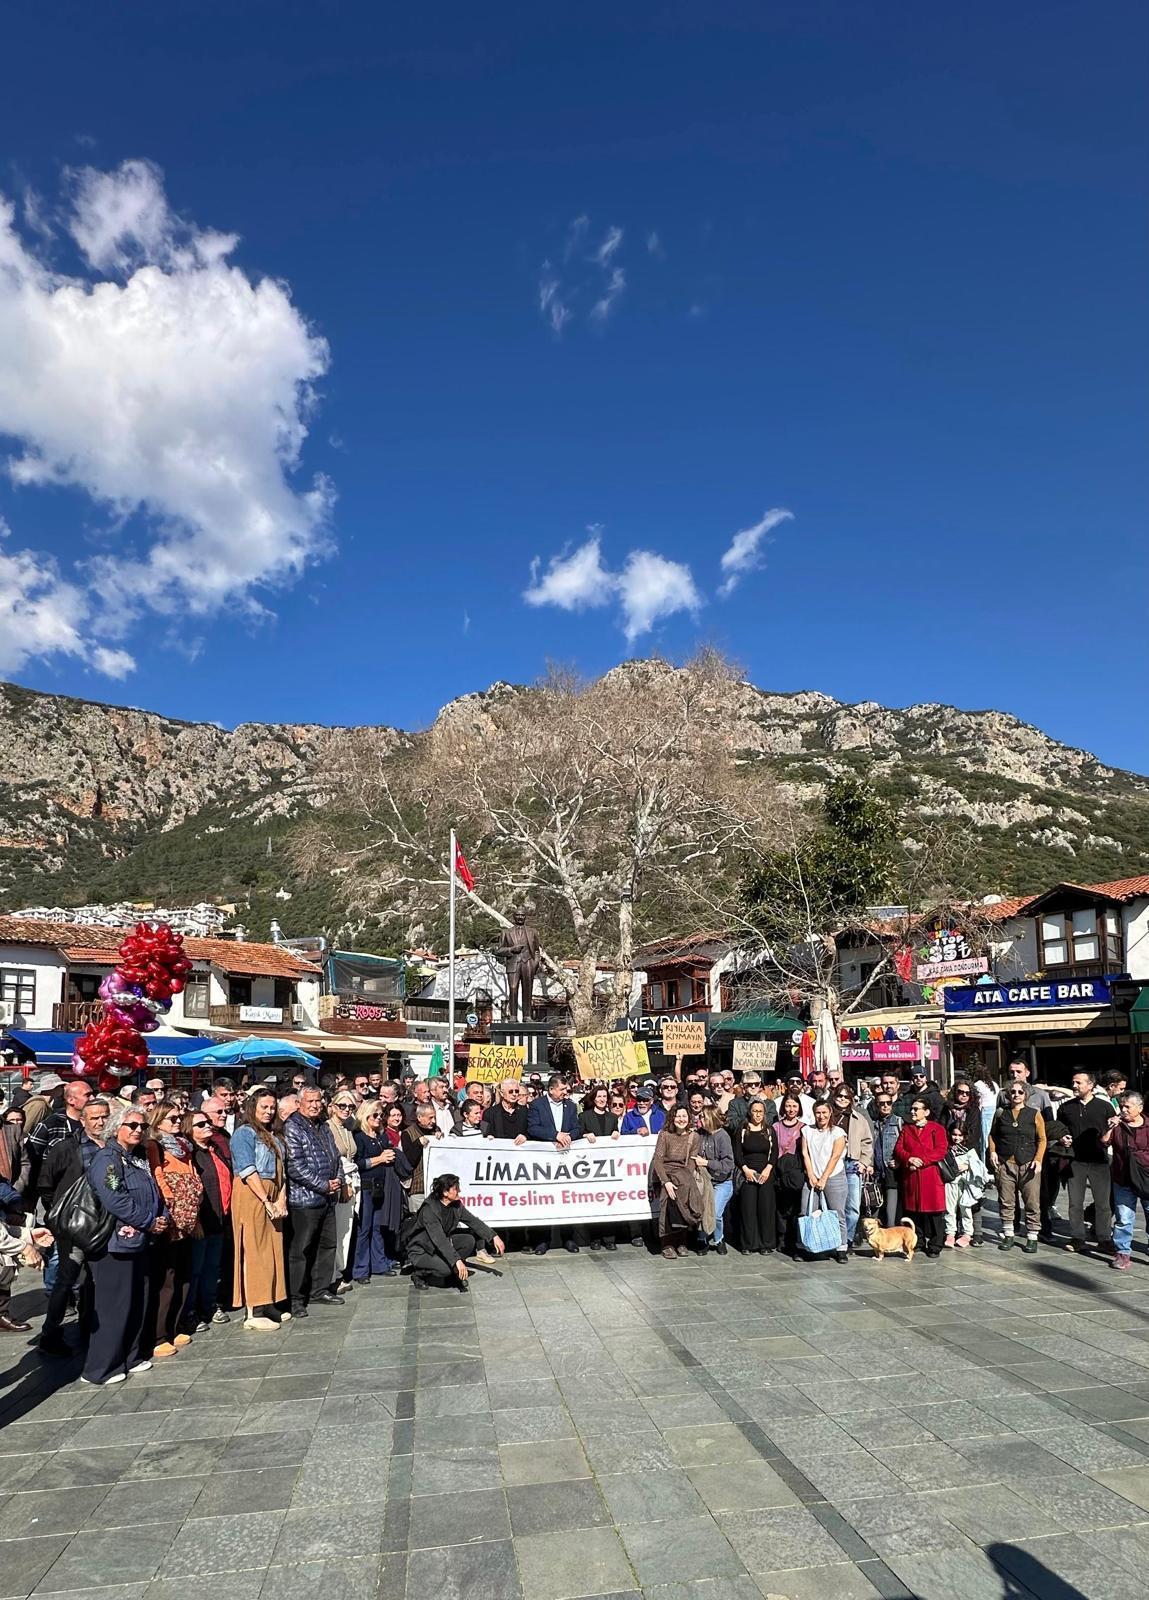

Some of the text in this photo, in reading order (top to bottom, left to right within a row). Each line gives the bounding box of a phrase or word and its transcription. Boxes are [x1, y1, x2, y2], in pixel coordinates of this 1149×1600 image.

[941, 936, 964, 945] TOP
[974, 983, 1095, 1004] ATA CAFE BAR
[665, 1024, 702, 1033] KIYILARA
[665, 1033, 702, 1041] KIYMAYIN
[588, 1048, 625, 1064] RANTA
[459, 1188, 657, 1208] anta Teslim Etmeyece
